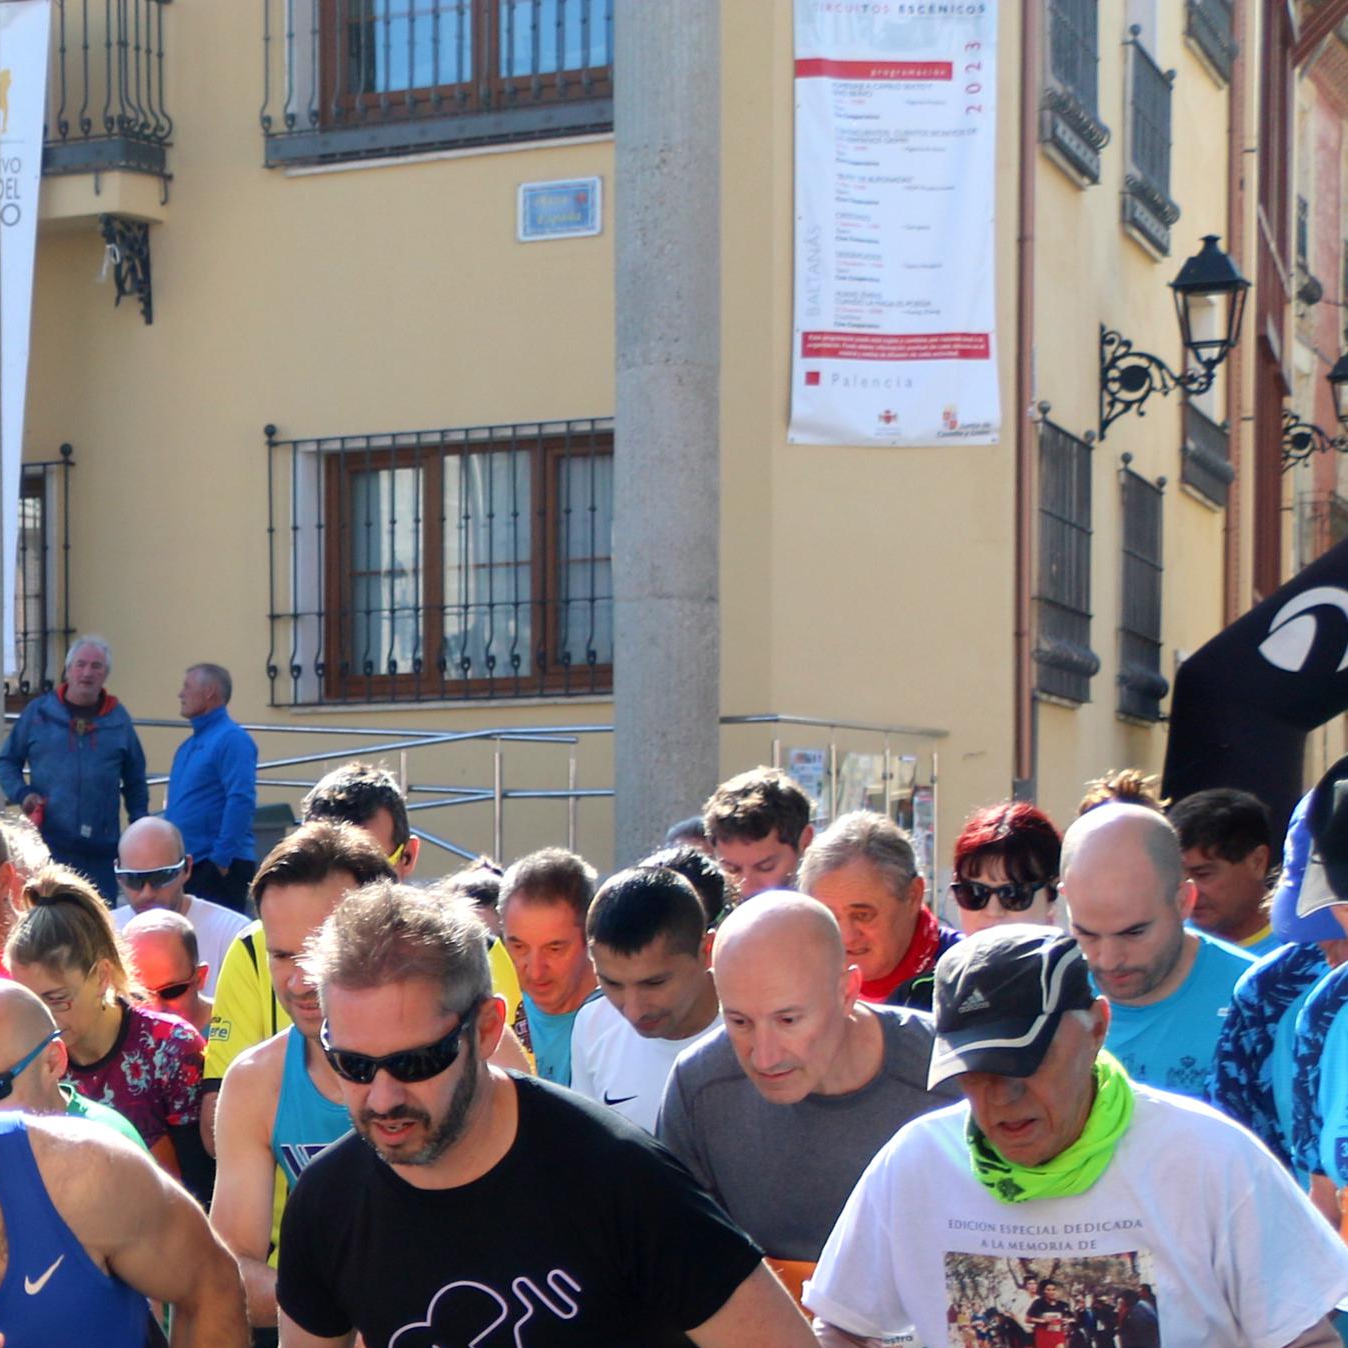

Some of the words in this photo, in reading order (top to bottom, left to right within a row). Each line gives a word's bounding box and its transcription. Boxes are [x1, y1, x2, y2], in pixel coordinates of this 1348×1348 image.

[965, 41, 982, 114] 2023
[831, 373, 913, 389] Palencia
[999, 1222, 1059, 1236] ESPECIAL
[1063, 1219, 1144, 1235] DEDICADA
[981, 1239, 988, 1249] A
[991, 1239, 1004, 1250] LA
[1008, 1241, 1073, 1251] MEMORIA
[1078, 1239, 1097, 1250] DE
